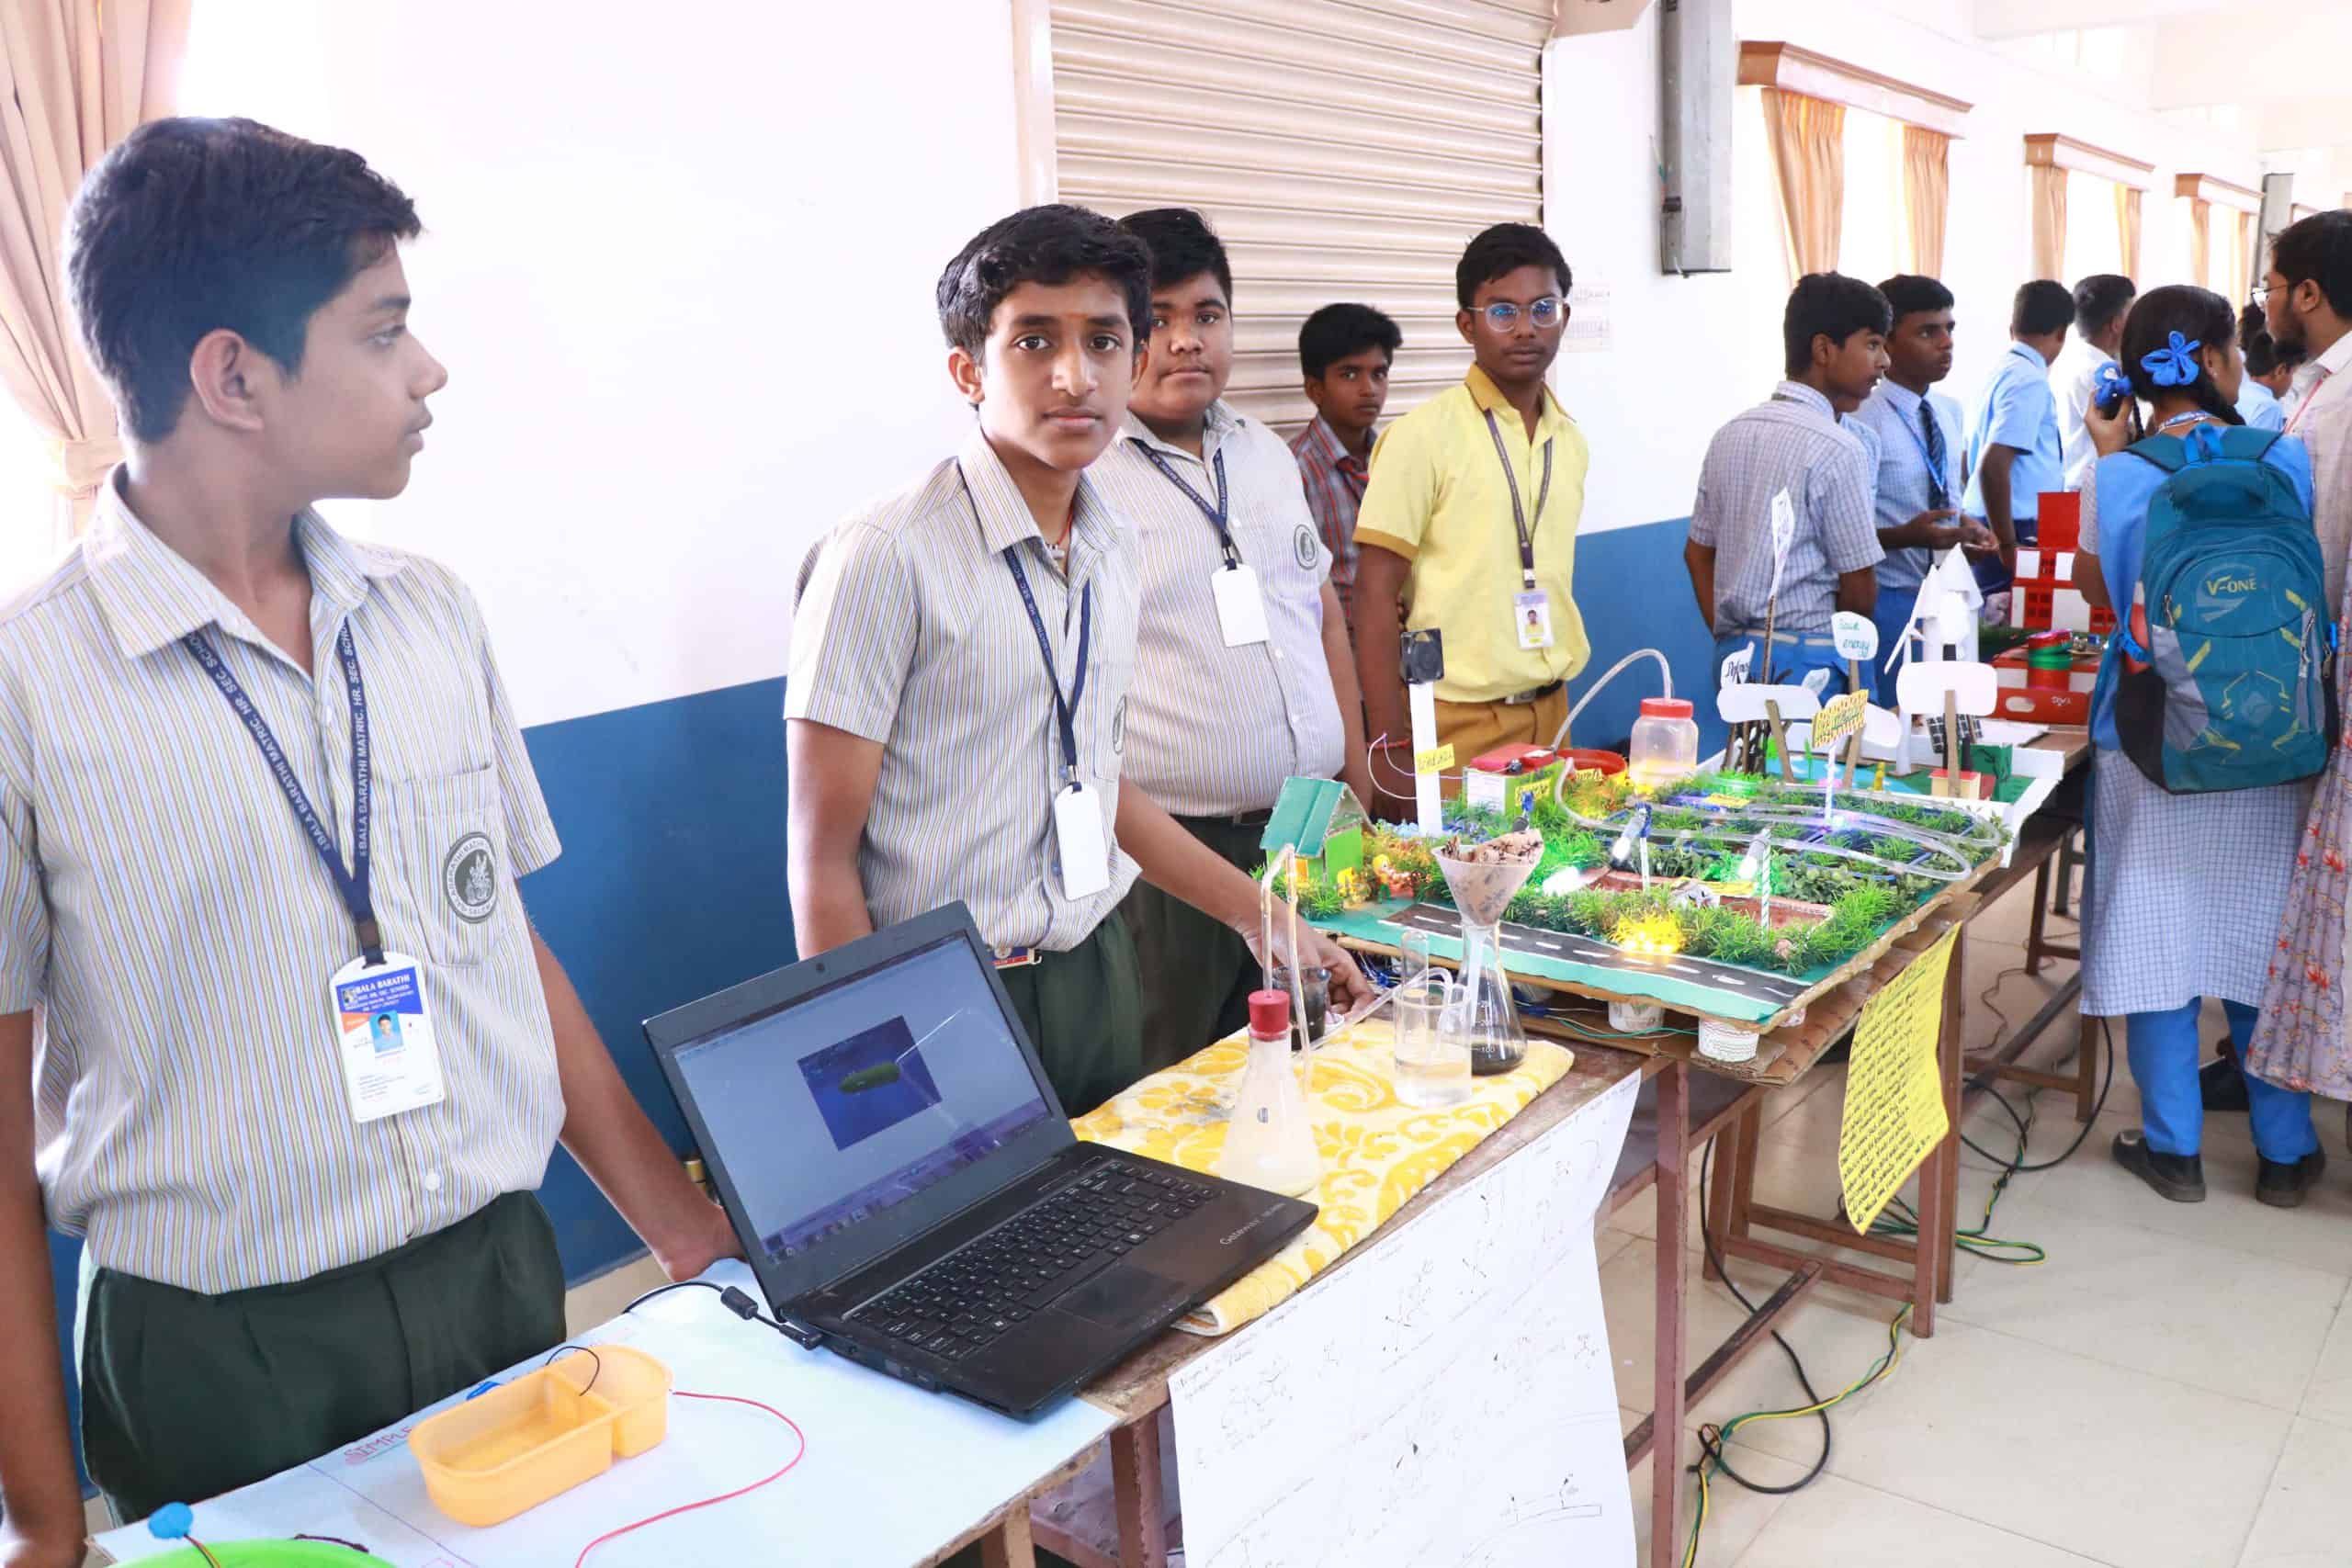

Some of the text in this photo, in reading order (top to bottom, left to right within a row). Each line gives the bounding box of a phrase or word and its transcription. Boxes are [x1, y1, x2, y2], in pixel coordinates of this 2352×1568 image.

[212, 664, 238, 694] SEC.
[347, 659, 359, 683] SEC.
[232, 692, 252, 715] HR.
[352, 687, 363, 706] HR.
[245, 713, 283, 762] MATRIC.
[355, 709, 368, 757] MATRIC.
[272, 761, 311, 813] BARATHI
[356, 761, 369, 813] BARATHI
[303, 811, 329, 844] BALA
[357, 817, 368, 848] BALA
